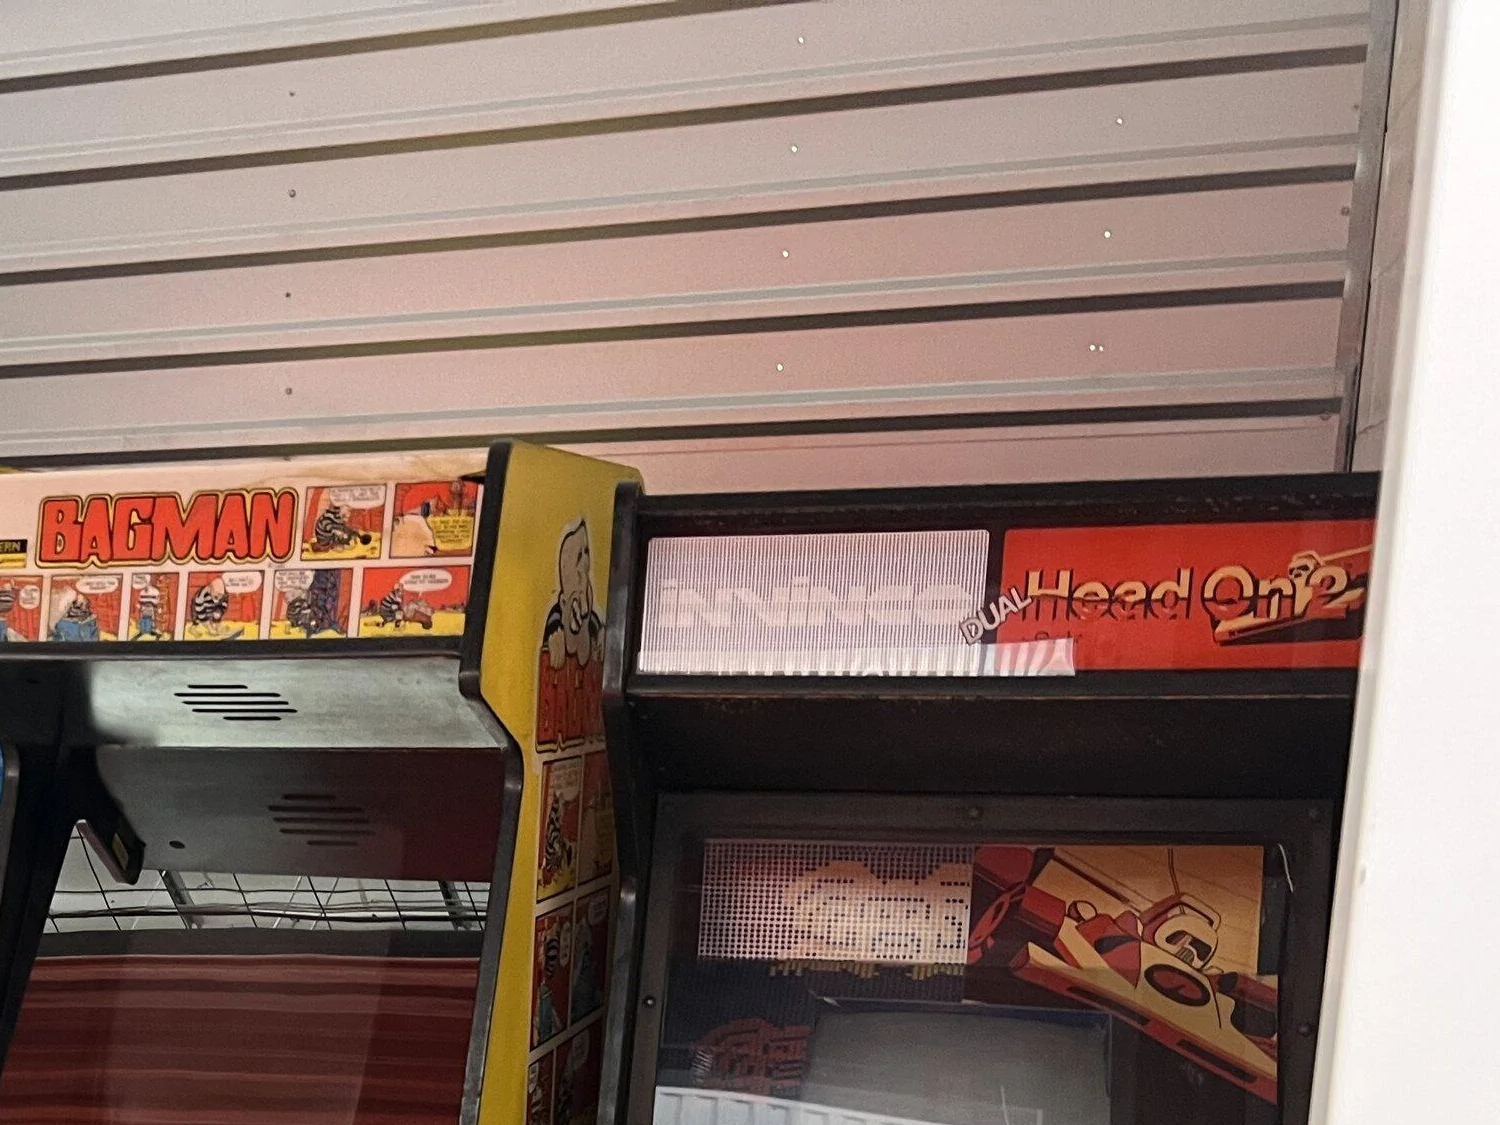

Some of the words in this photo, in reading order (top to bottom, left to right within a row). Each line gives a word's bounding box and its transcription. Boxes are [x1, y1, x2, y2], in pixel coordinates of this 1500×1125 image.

[39, 489, 297, 566] BAGMAN
[1022, 567, 1194, 621] Head
[1202, 565, 1296, 621] On
